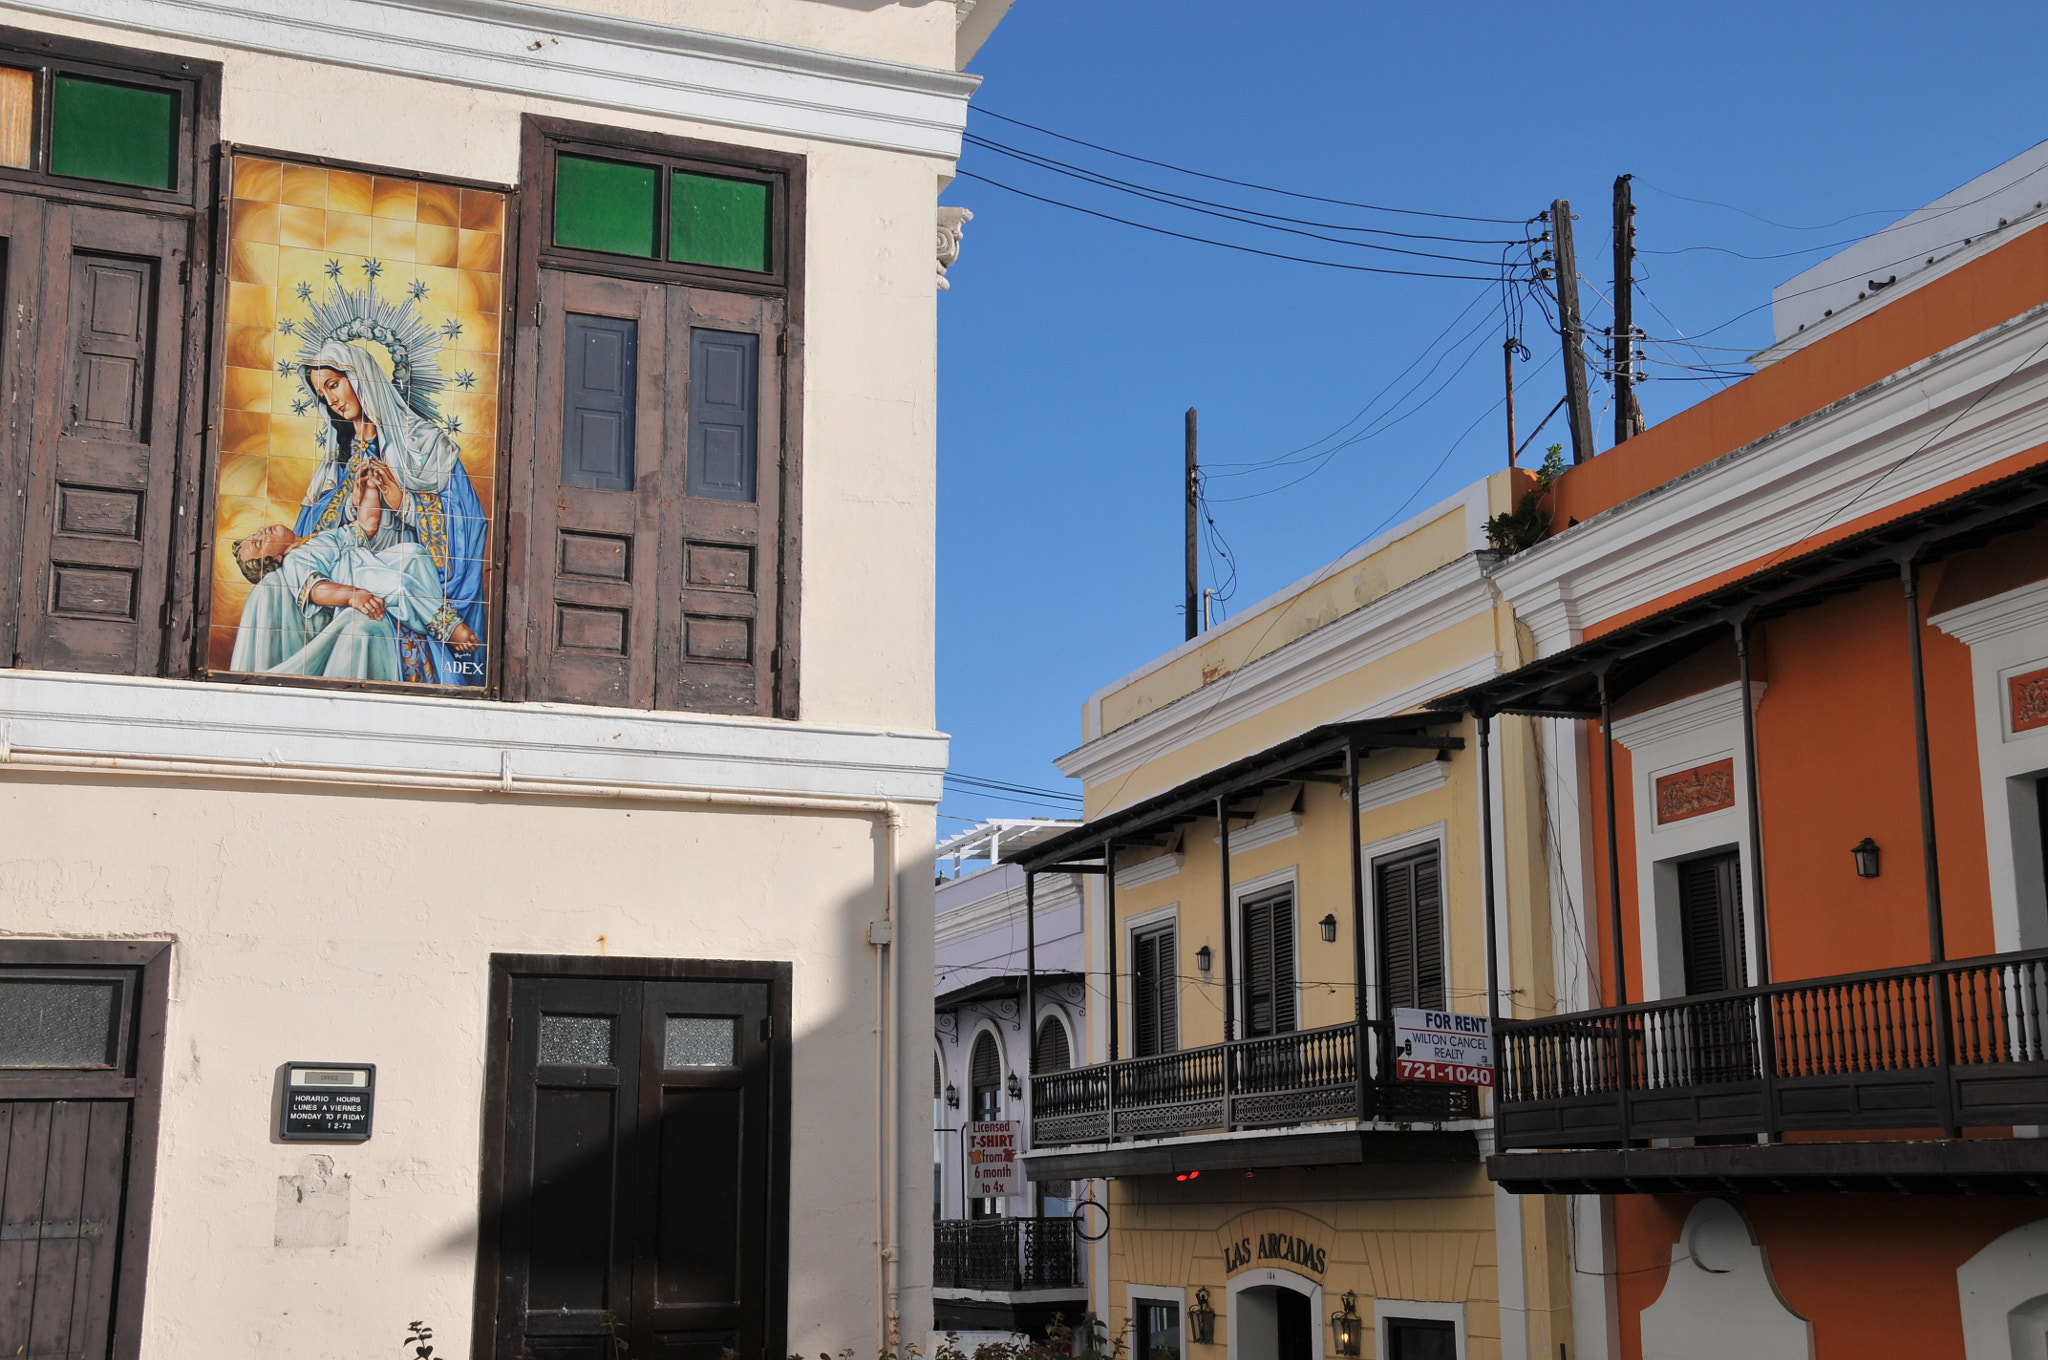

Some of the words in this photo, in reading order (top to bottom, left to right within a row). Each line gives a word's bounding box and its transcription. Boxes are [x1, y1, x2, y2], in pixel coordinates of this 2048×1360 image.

[442, 660, 484, 675] ADEX
[1425, 1012, 1452, 1030] FOR
[1454, 1015, 1487, 1033] RENT
[1412, 1032, 1447, 1046] WILTON
[1449, 1036, 1487, 1050] CANCEL
[1434, 1047, 1465, 1060] REALTY
[1401, 1061, 1491, 1085] 721-1040
[973, 1121, 1010, 1133] Licensed
[970, 1135, 1014, 1148] T-SHIRT
[982, 1149, 1003, 1163] from
[974, 1166, 980, 1179] 6
[983, 1164, 1012, 1178] month
[981, 1183, 991, 1194] to
[993, 1180, 1005, 1193] 4x
[1223, 1237, 1251, 1274] LAS
[1257, 1233, 1326, 1275] ARCADAS
